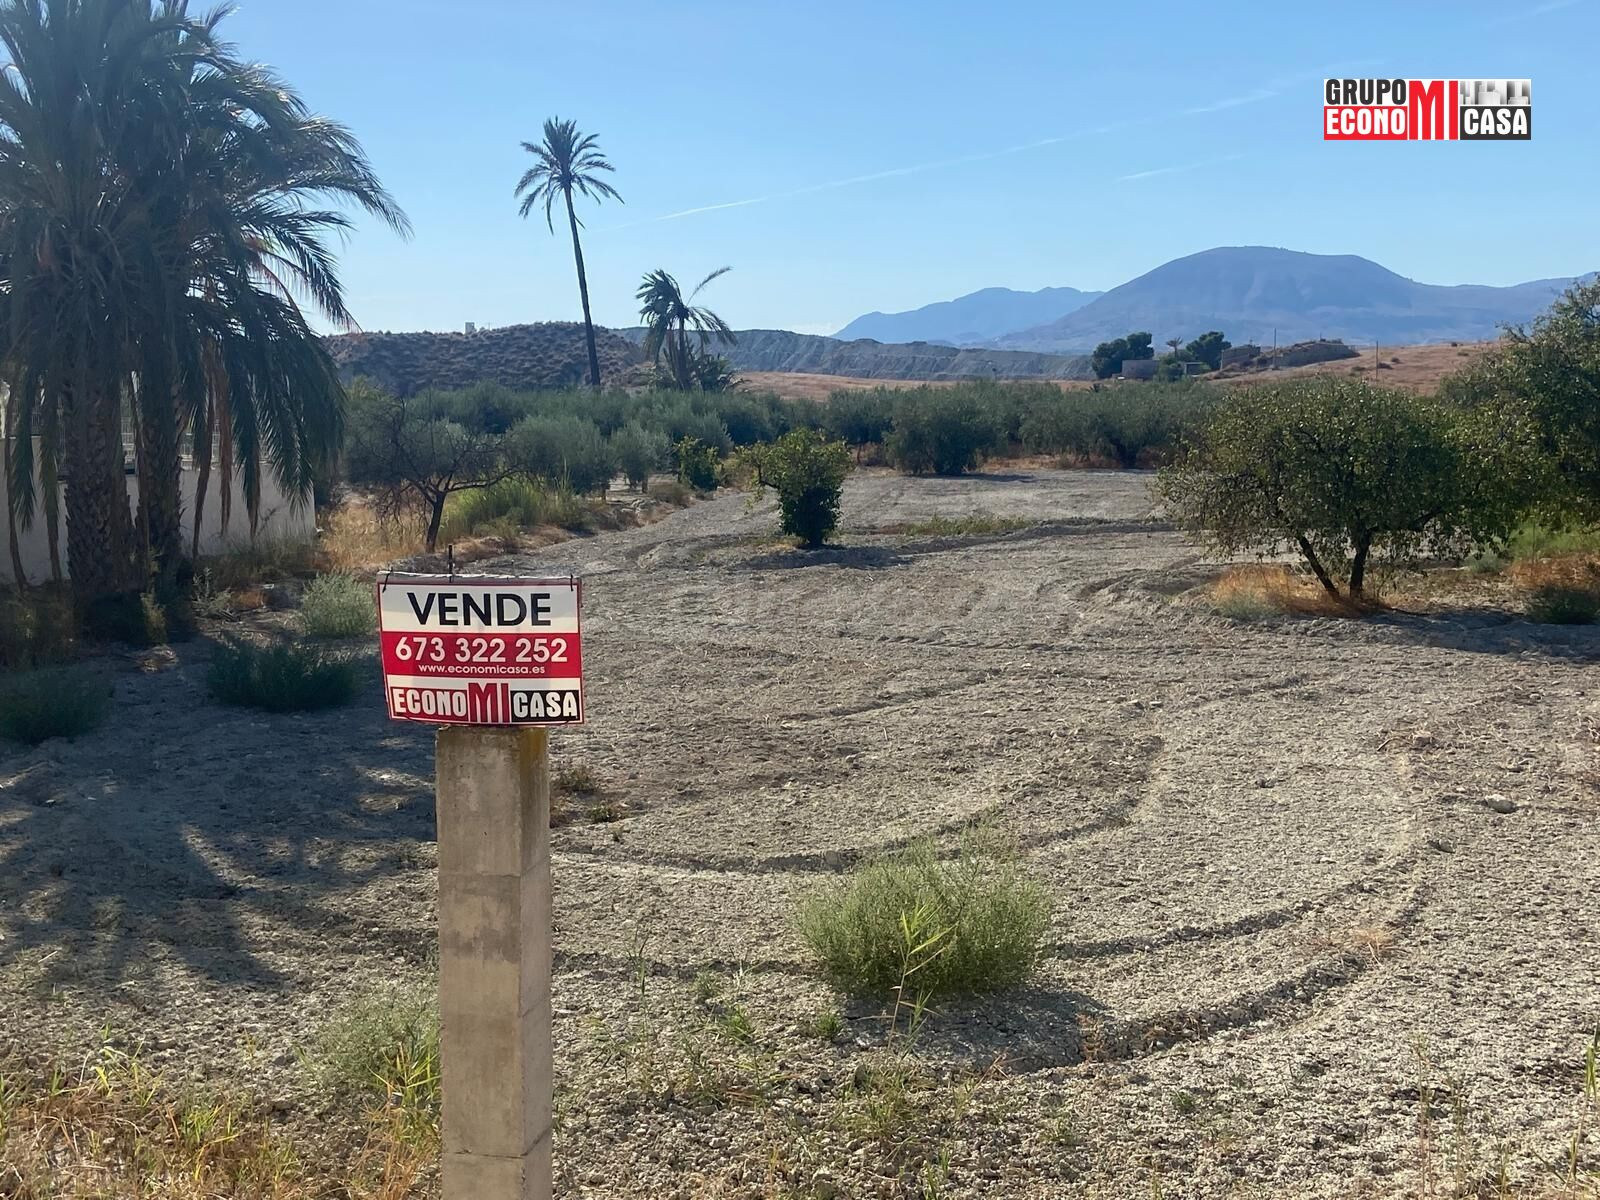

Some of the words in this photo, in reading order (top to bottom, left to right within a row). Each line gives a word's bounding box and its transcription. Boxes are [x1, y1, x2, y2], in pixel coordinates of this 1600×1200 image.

[407, 592, 551, 627] VENDE
[395, 637, 446, 662] 673
[455, 638, 506, 663] 322
[515, 638, 568, 663] 252
[418, 664, 545, 674] www.economicasa.es
